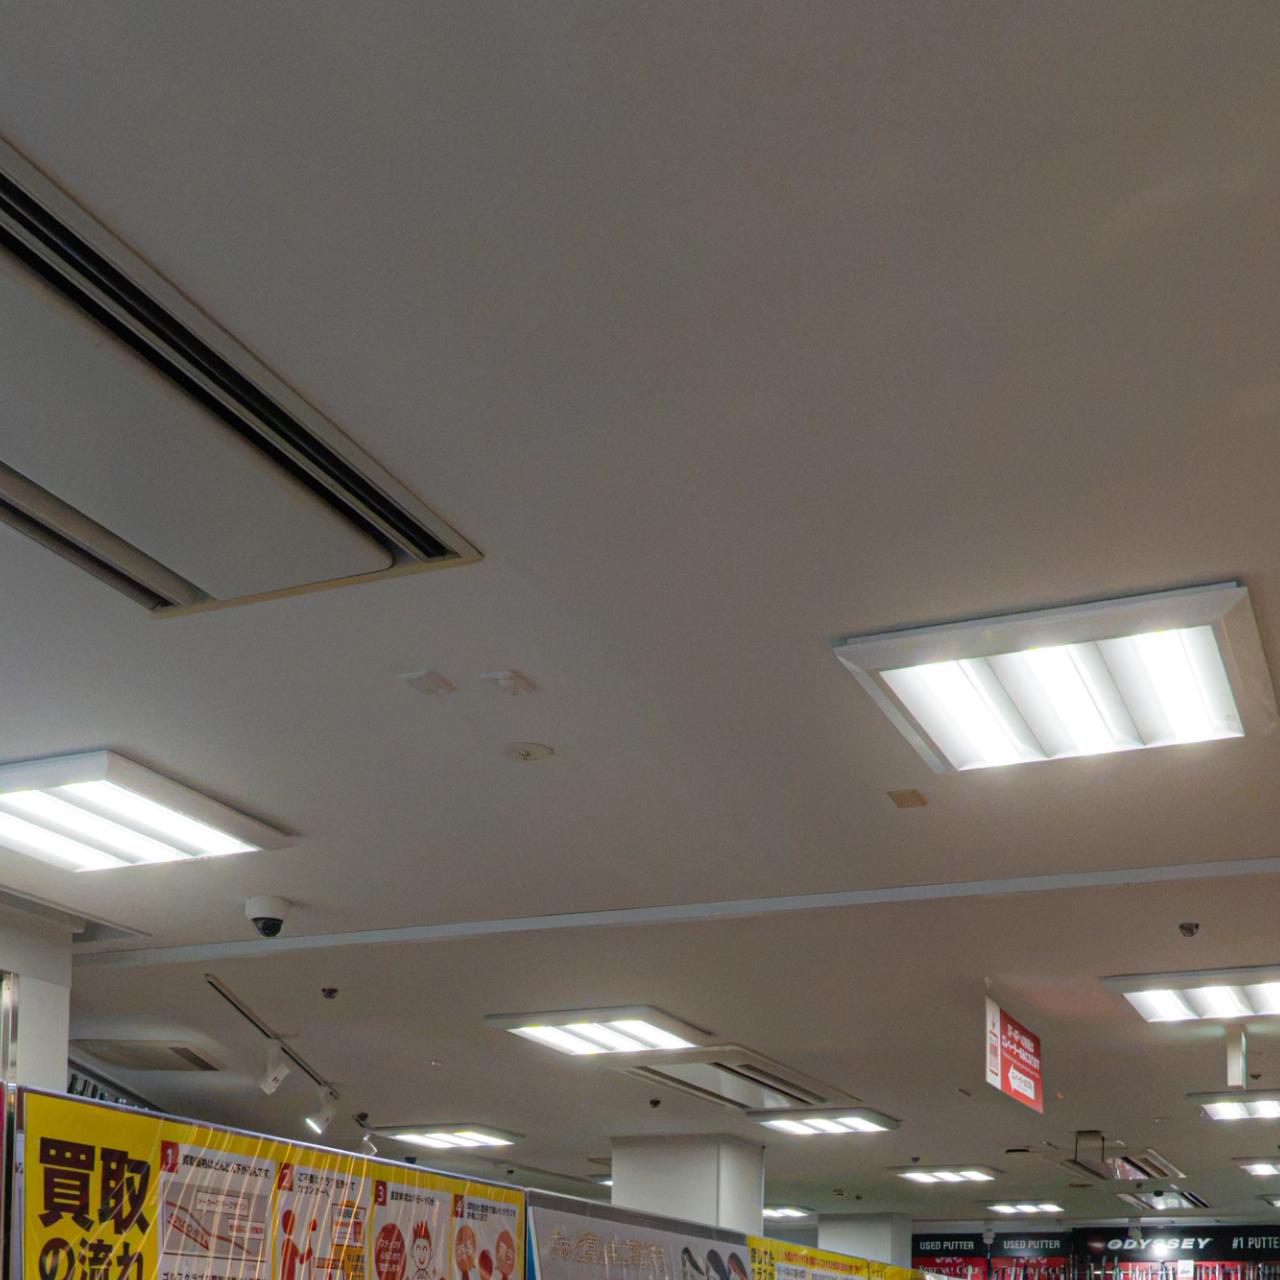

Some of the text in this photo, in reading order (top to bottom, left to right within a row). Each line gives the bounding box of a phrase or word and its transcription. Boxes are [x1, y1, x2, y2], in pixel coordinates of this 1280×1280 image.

[38, 1136, 151, 1237] 買取
[920, 1241, 974, 1250] USED PUTTER
[1004, 1239, 1061, 1249] USED PUTTER
[1107, 1237, 1212, 1251] ODYSSEY
[1232, 1237, 1245, 1249] #1
